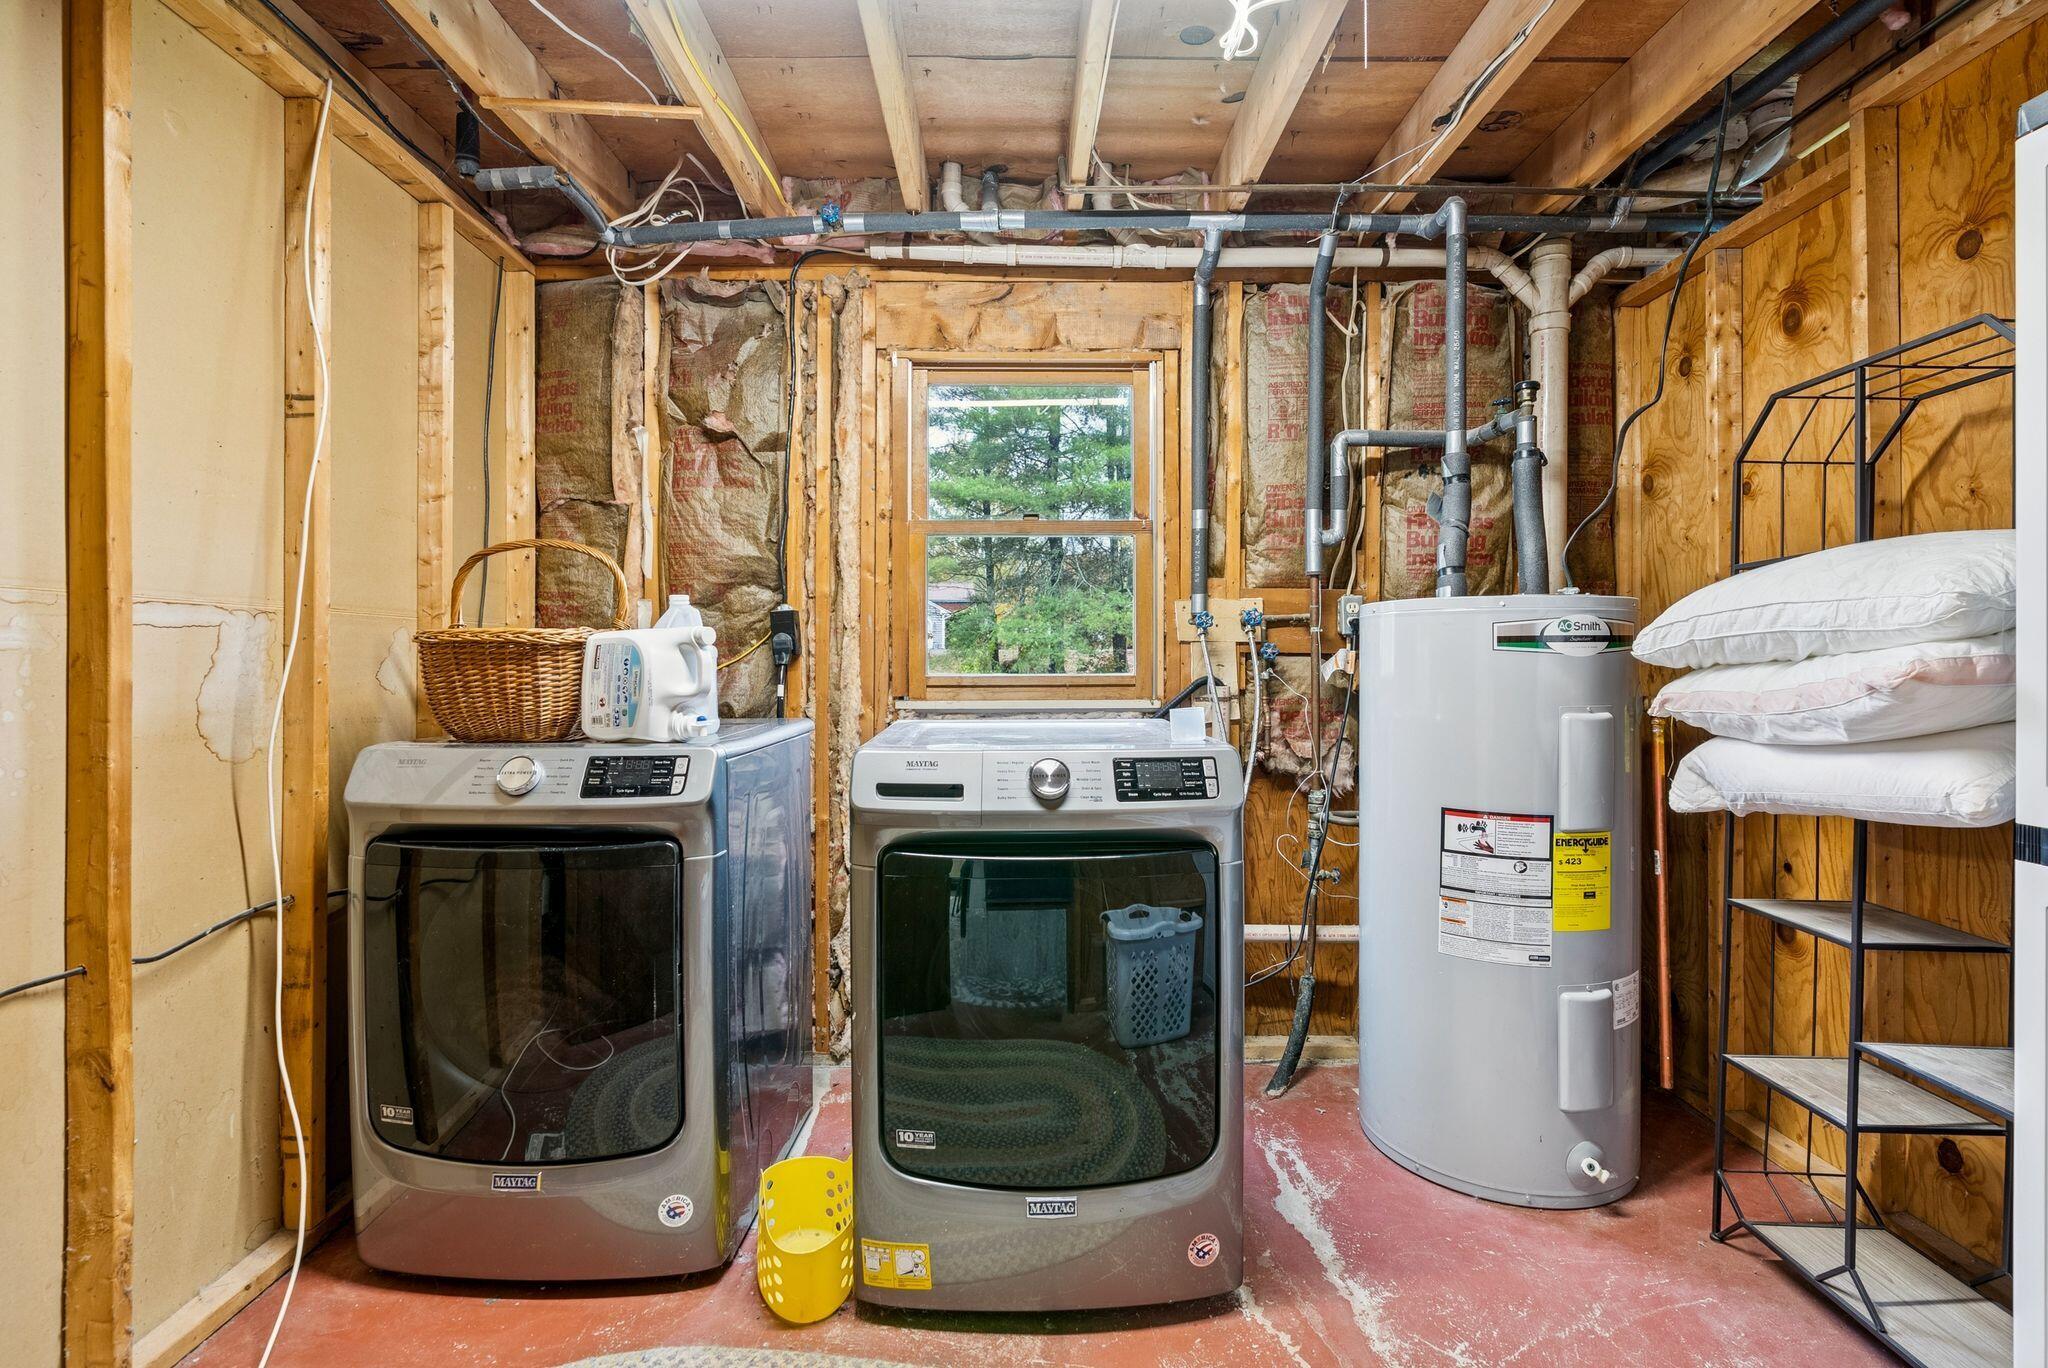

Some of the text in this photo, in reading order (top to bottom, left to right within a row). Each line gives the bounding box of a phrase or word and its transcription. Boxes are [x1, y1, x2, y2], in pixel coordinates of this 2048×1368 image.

[1574, 622, 1601, 631] Smith
[1565, 857, 1582, 865] 423
[382, 1106, 396, 1117] 10
[899, 1131, 914, 1142] 10
[494, 1177, 537, 1188] MAYTAG
[1029, 1202, 1075, 1214] MAYTAG
